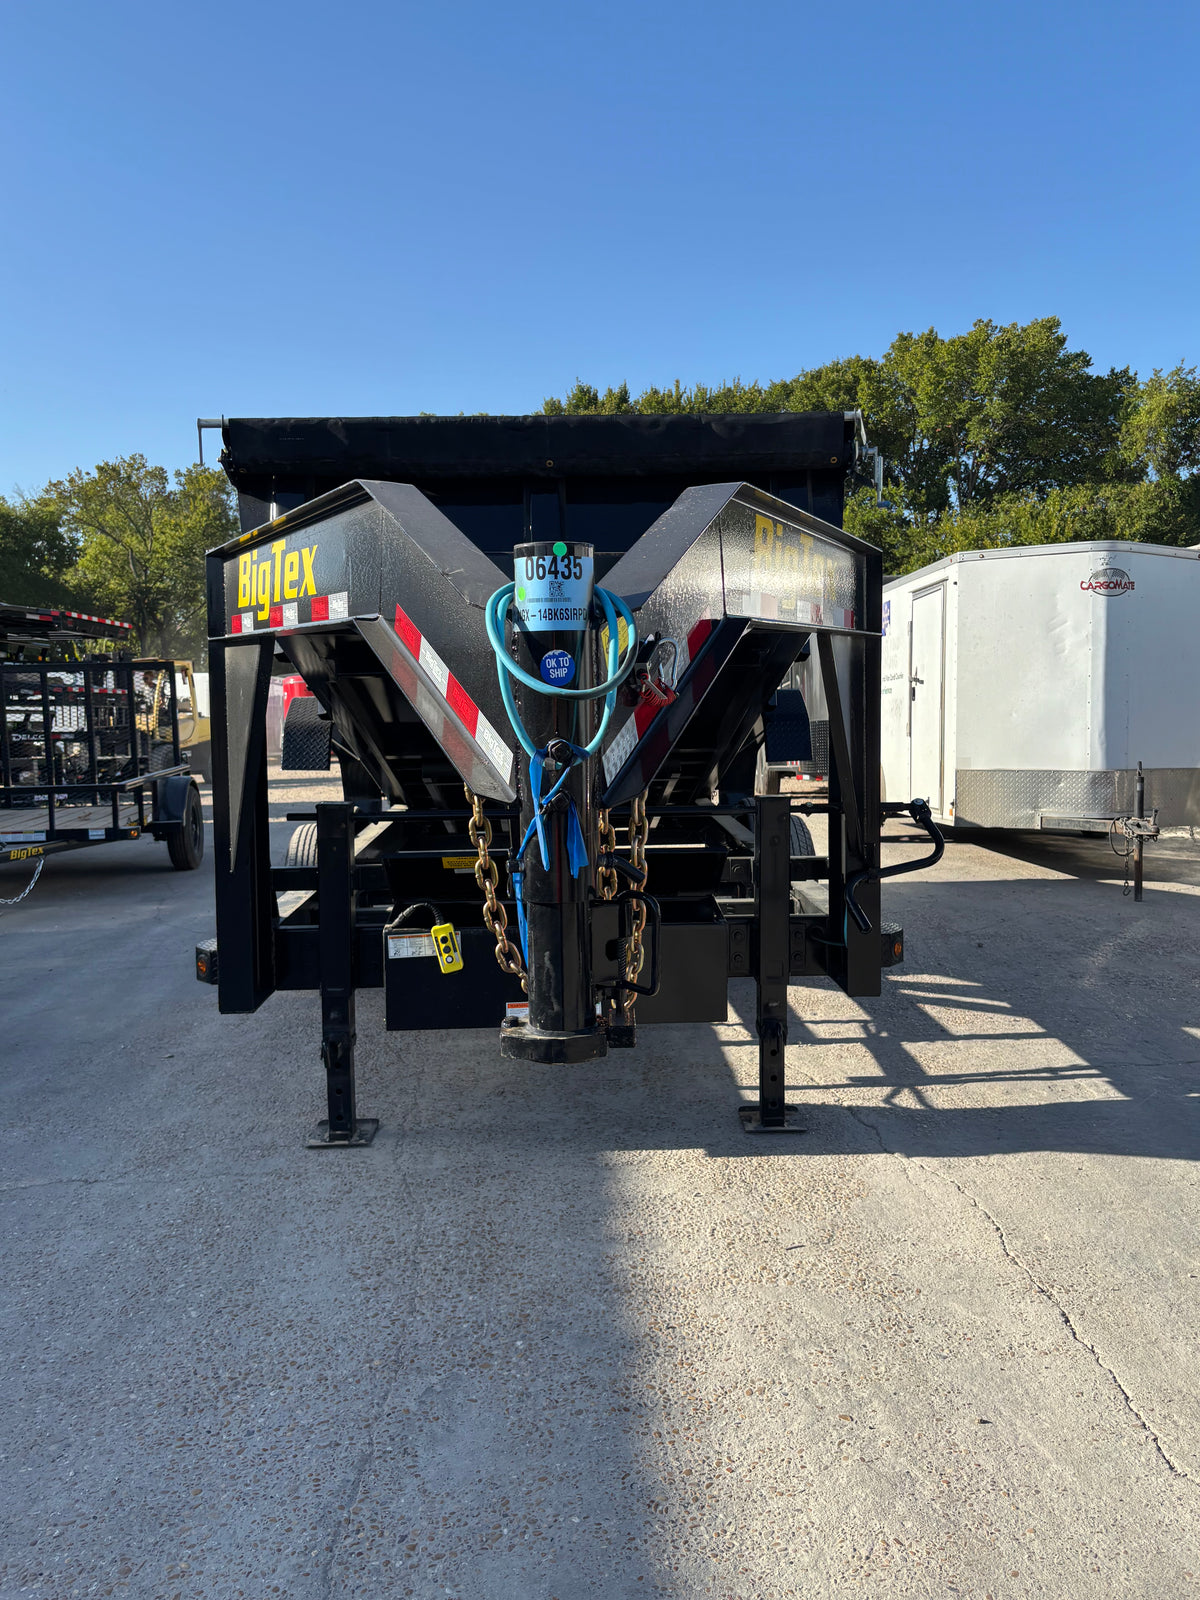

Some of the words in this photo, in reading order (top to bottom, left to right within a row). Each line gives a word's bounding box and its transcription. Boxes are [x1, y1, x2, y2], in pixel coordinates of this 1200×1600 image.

[525, 555, 583, 581] 06435
[238, 539, 318, 621] BigTex
[545, 658, 557, 669] OK
[558, 657, 570, 667] TO
[549, 667, 568, 679] SHIP
[9, 847, 44, 860] BigTex
